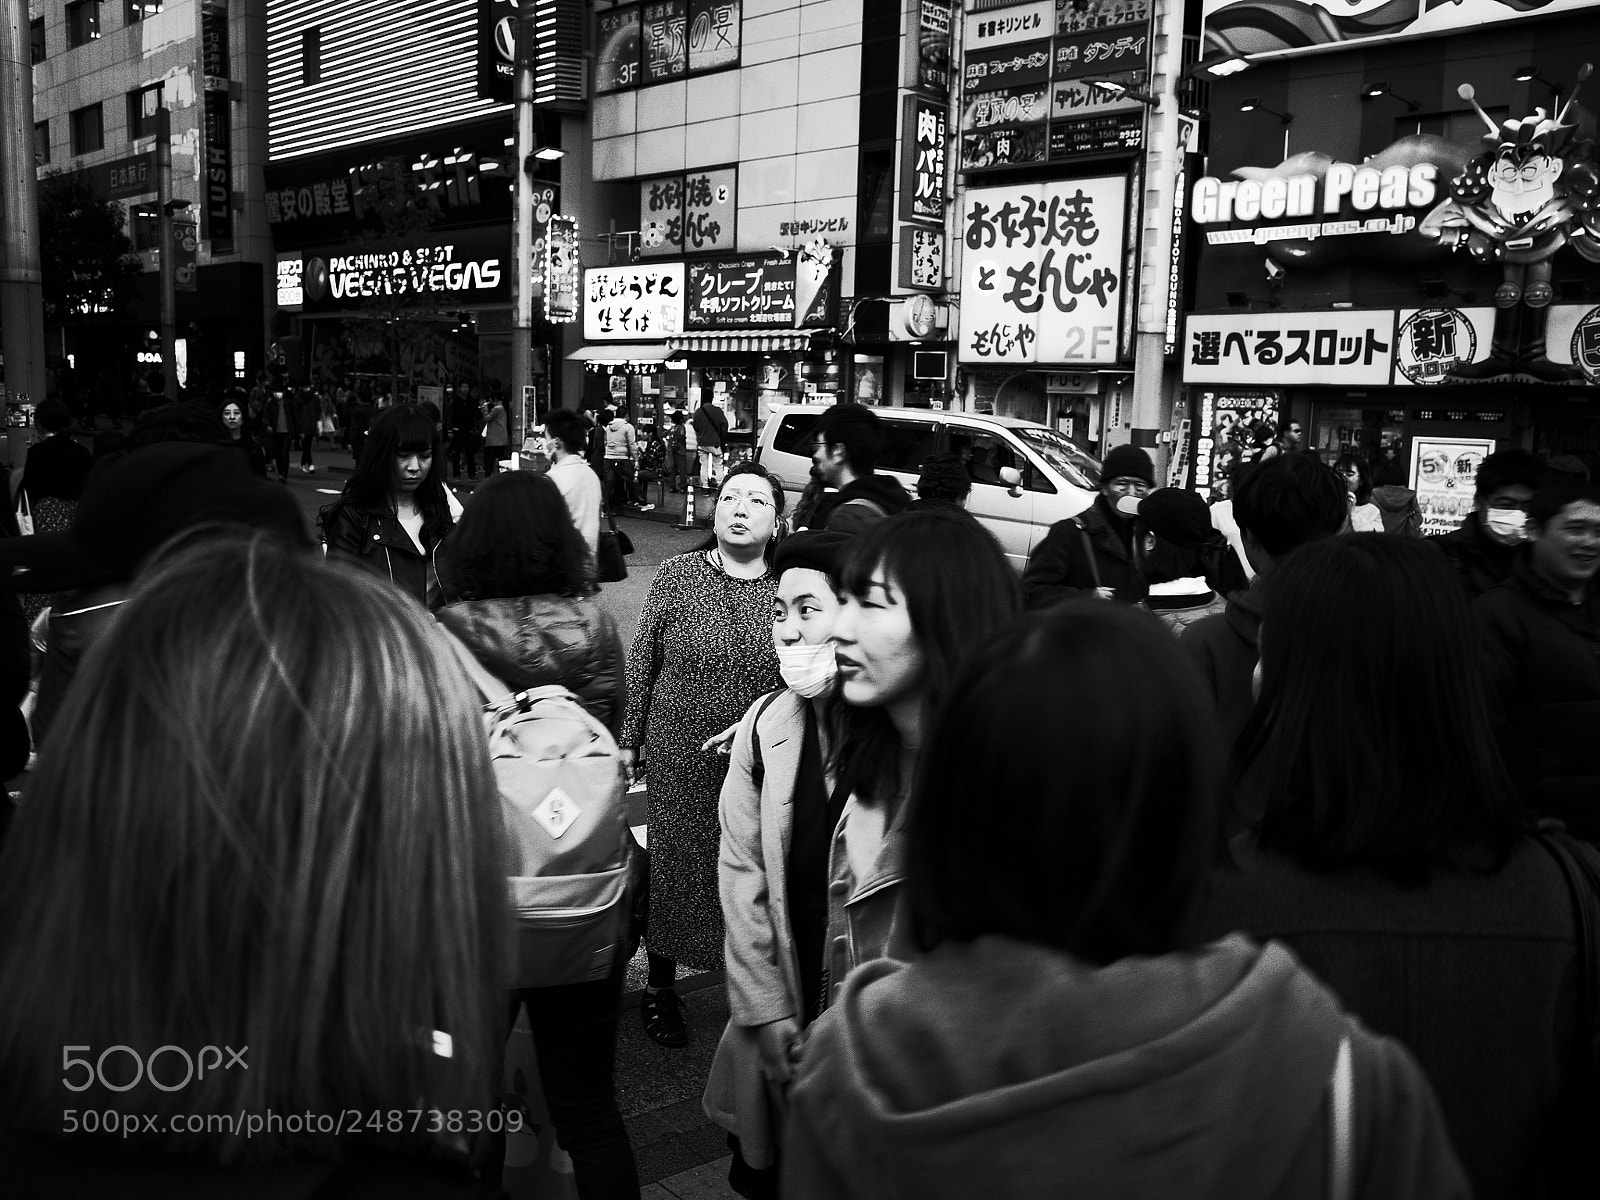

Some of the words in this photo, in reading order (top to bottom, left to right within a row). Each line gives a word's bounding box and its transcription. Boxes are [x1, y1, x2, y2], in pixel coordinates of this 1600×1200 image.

[978, 13, 1041, 38] 新宿キリンビル
[1084, 36, 1146, 63] ダンディ
[620, 62, 638, 84] 3F
[651, 67, 668, 77] TEL
[915, 108, 937, 199] 肉バル
[210, 148, 228, 218] LUSH
[1191, 176, 1317, 224] Green
[1323, 163, 1437, 214] Peas
[665, 211, 721, 248] もんじゃ
[966, 188, 1100, 250] お好焼
[1206, 213, 1416, 245] www.greenpeas.co.jp
[329, 251, 399, 273] PACHINKO
[402, 250, 412, 265] &
[410, 259, 501, 293] VEGAS
[700, 267, 764, 296] クレープ
[978, 266, 996, 291] と
[1003, 248, 1118, 314] もんじゃ
[598, 306, 652, 333] 生そば
[700, 293, 795, 314] 牛乳ソフトクリーム
[1064, 325, 1114, 360] 2F
[1191, 328, 1389, 366] 選べるスロット
[1410, 312, 1456, 362] 新
